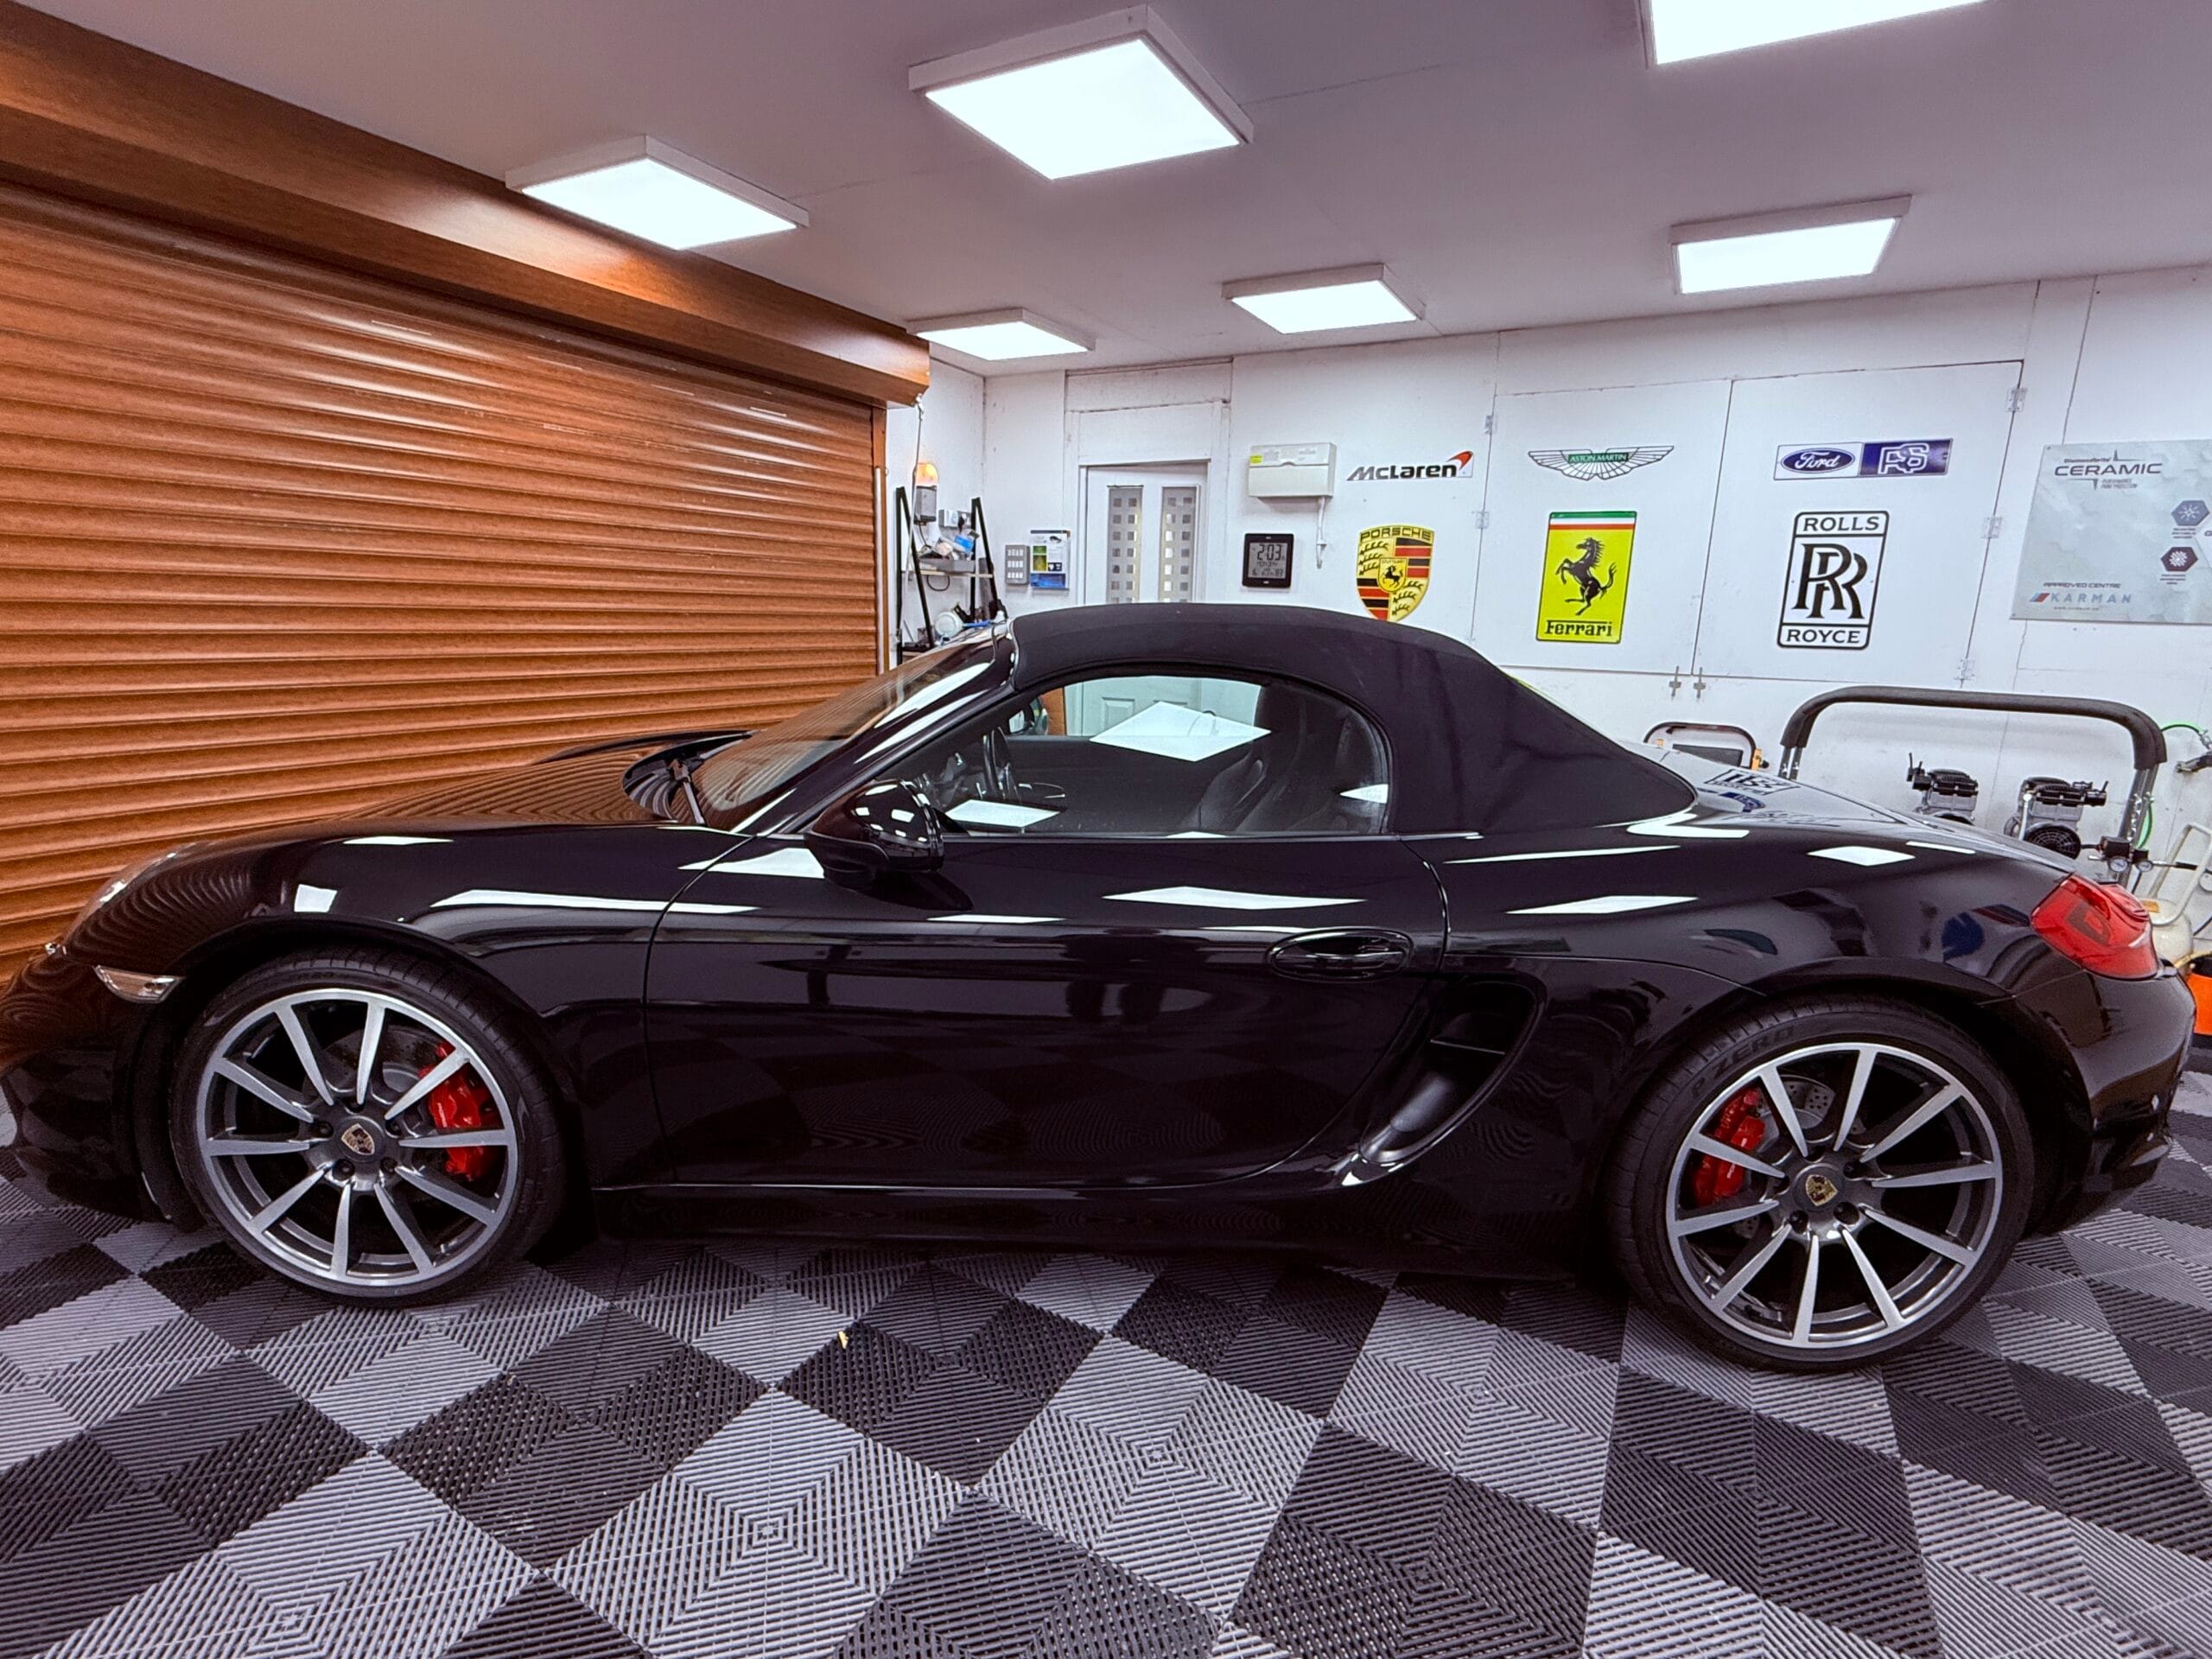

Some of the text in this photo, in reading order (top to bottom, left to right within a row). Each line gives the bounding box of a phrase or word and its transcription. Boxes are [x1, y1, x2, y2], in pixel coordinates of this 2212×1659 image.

[1569, 454, 1628, 463] ASTON MARTIN
[1795, 451, 1840, 469] Ford
[1878, 442, 1929, 474] RS
[1346, 464, 1457, 480] McLaren
[2055, 462, 2163, 476] CERAMIC
[1802, 516, 1879, 531] ROLLS
[1359, 526, 1432, 542] PORSCHE
[2050, 593, 2133, 604] KARMAN
[1544, 620, 1612, 637] Ferrari
[1786, 629, 1860, 643] ROYCE
[1713, 1027, 1795, 1079] ZERO
